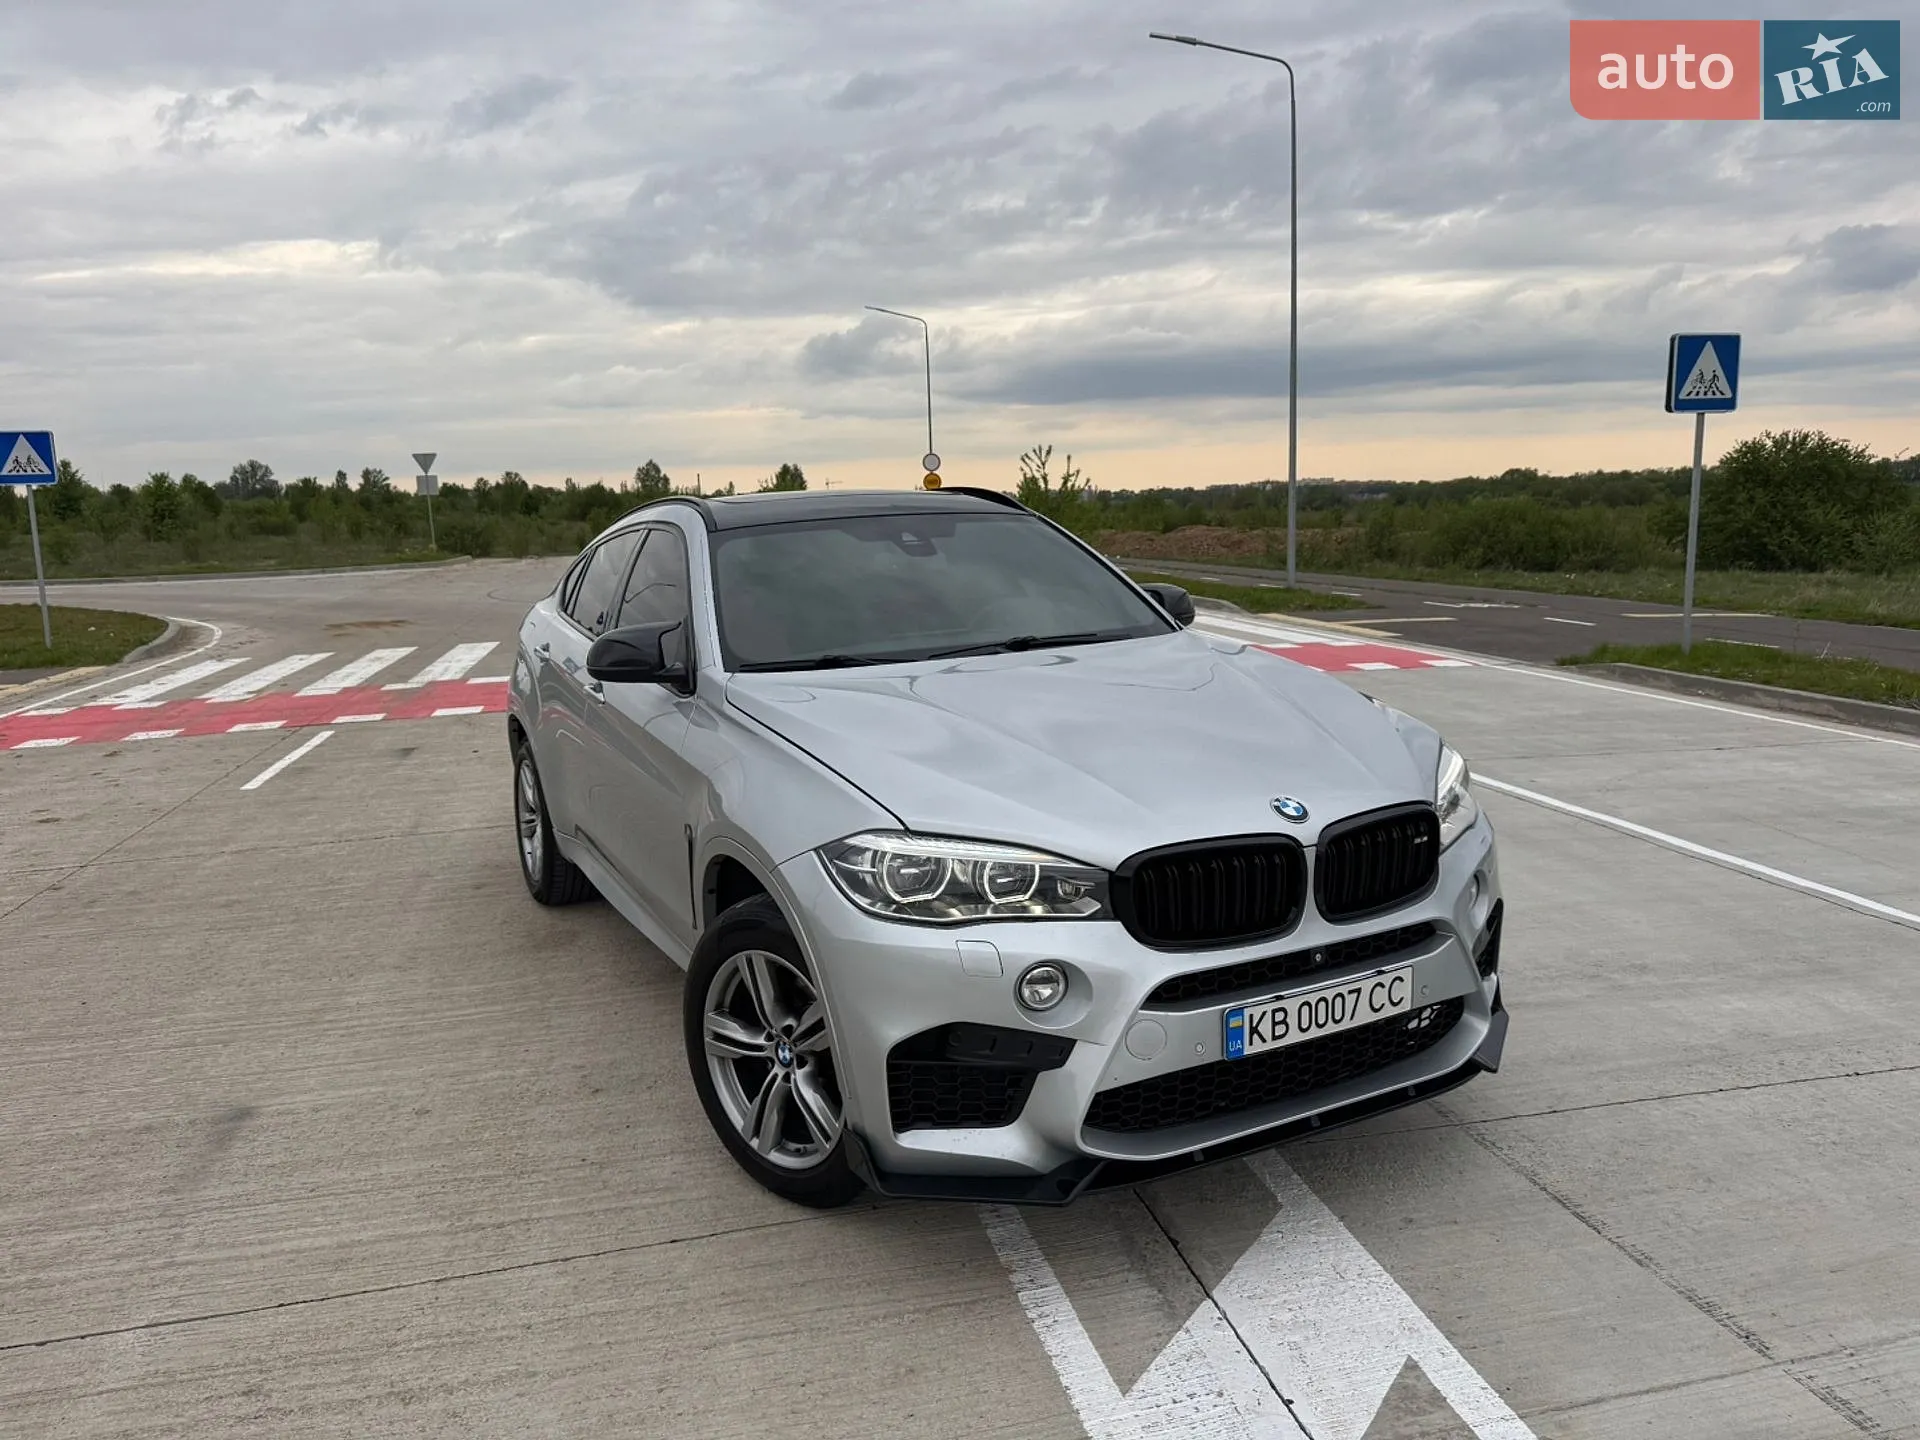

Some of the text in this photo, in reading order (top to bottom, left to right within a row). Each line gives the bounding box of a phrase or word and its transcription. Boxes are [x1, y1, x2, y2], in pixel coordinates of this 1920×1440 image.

[1248, 976, 1405, 1046] KB 0007 CC
[1229, 1039, 1243, 1052] UA
